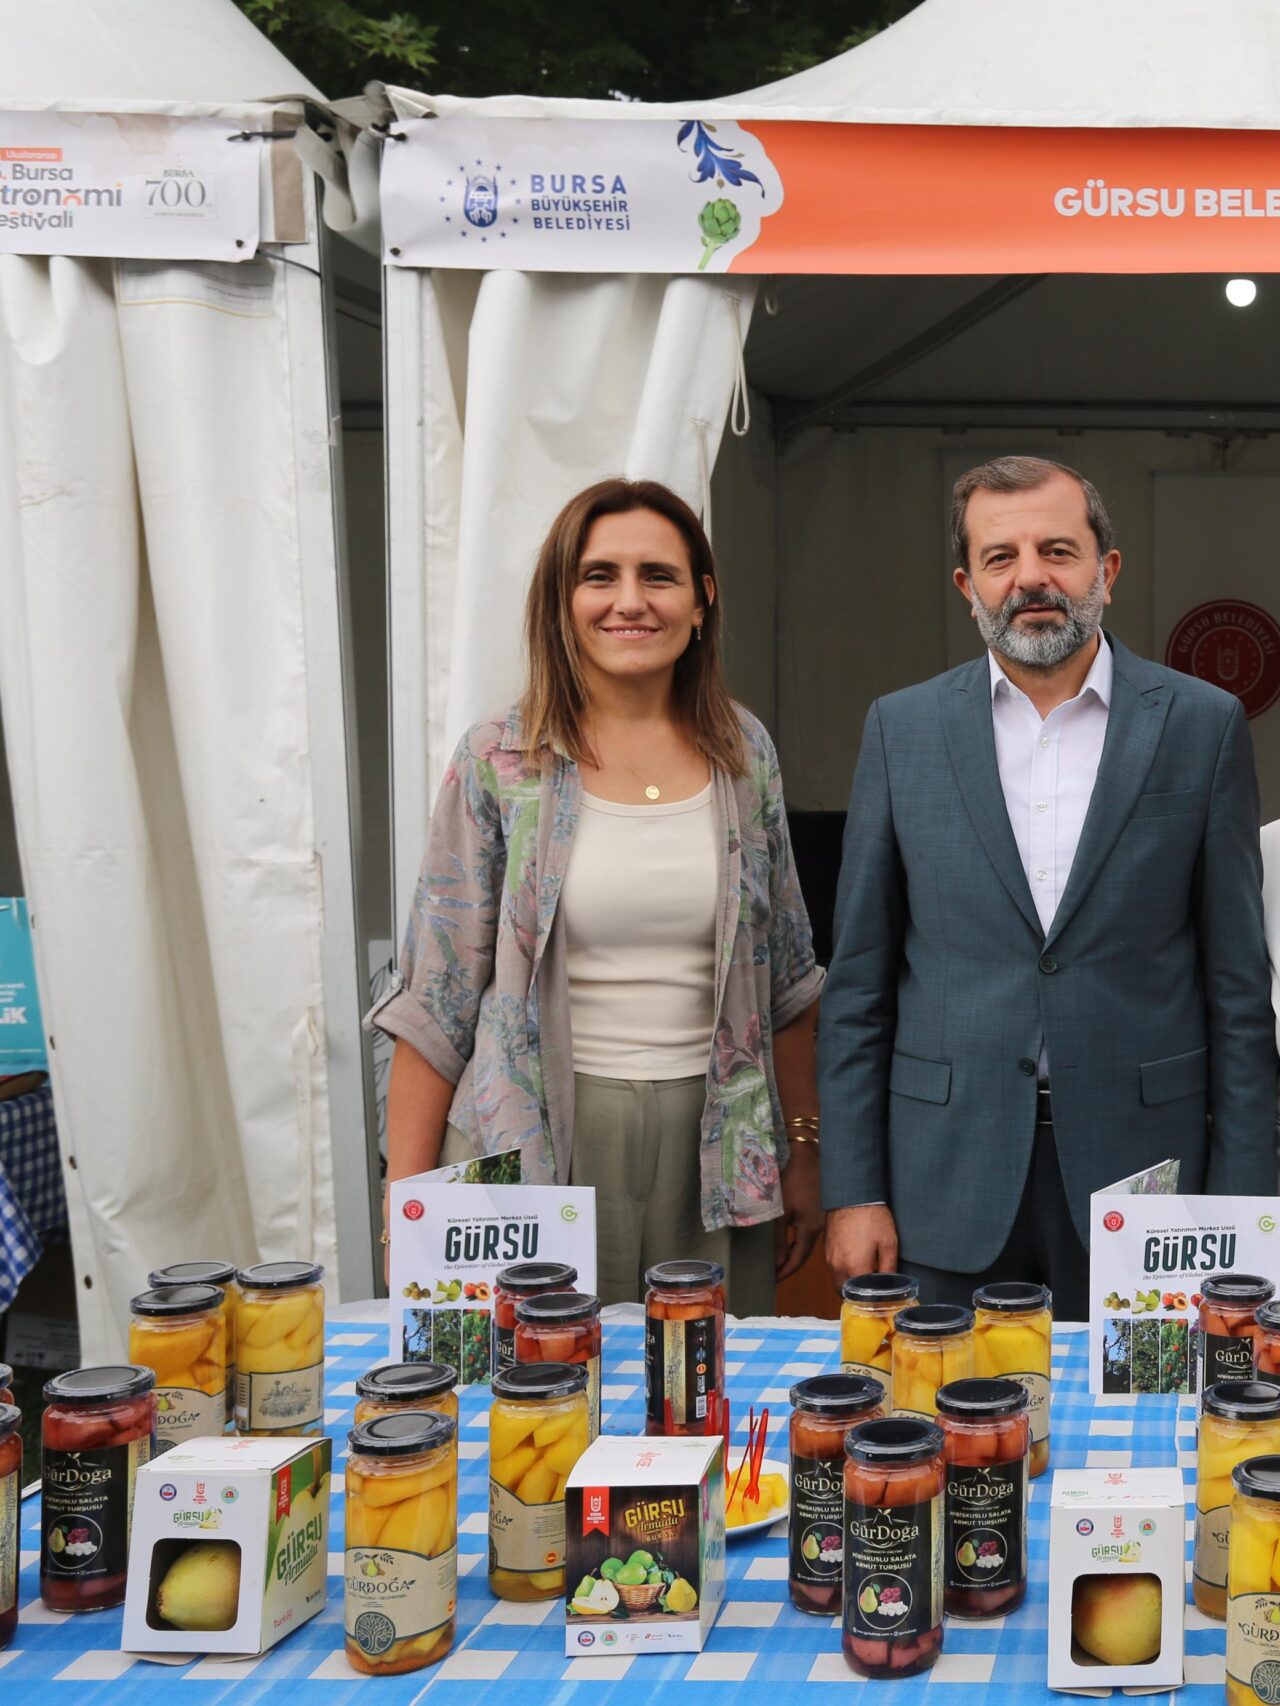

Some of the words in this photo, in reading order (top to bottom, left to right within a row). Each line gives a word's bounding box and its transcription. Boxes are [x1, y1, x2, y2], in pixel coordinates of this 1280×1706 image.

[12, 163, 73, 181] Bursa
[145, 180, 207, 207] 700
[530, 174, 628, 195] BURSA
[0, 184, 122, 207] tronomi
[1053, 179, 1185, 217] GÜRSU
[531, 196, 628, 217] BÜYÜKŞEHİR
[0, 209, 73, 230] estivali
[533, 214, 631, 231] BELEDİYESİ
[444, 1222, 539, 1263] GÜRSU
[1143, 1233, 1237, 1273] GÜRSU
[1215, 1349, 1254, 1363] GürD
[158, 1410, 201, 1426] DOĞA
[795, 1473, 844, 1494] GürDo
[624, 1498, 686, 1528] GÜRSU
[276, 1513, 323, 1581] GÜRSU
[890, 1553, 917, 1563] SALATA
